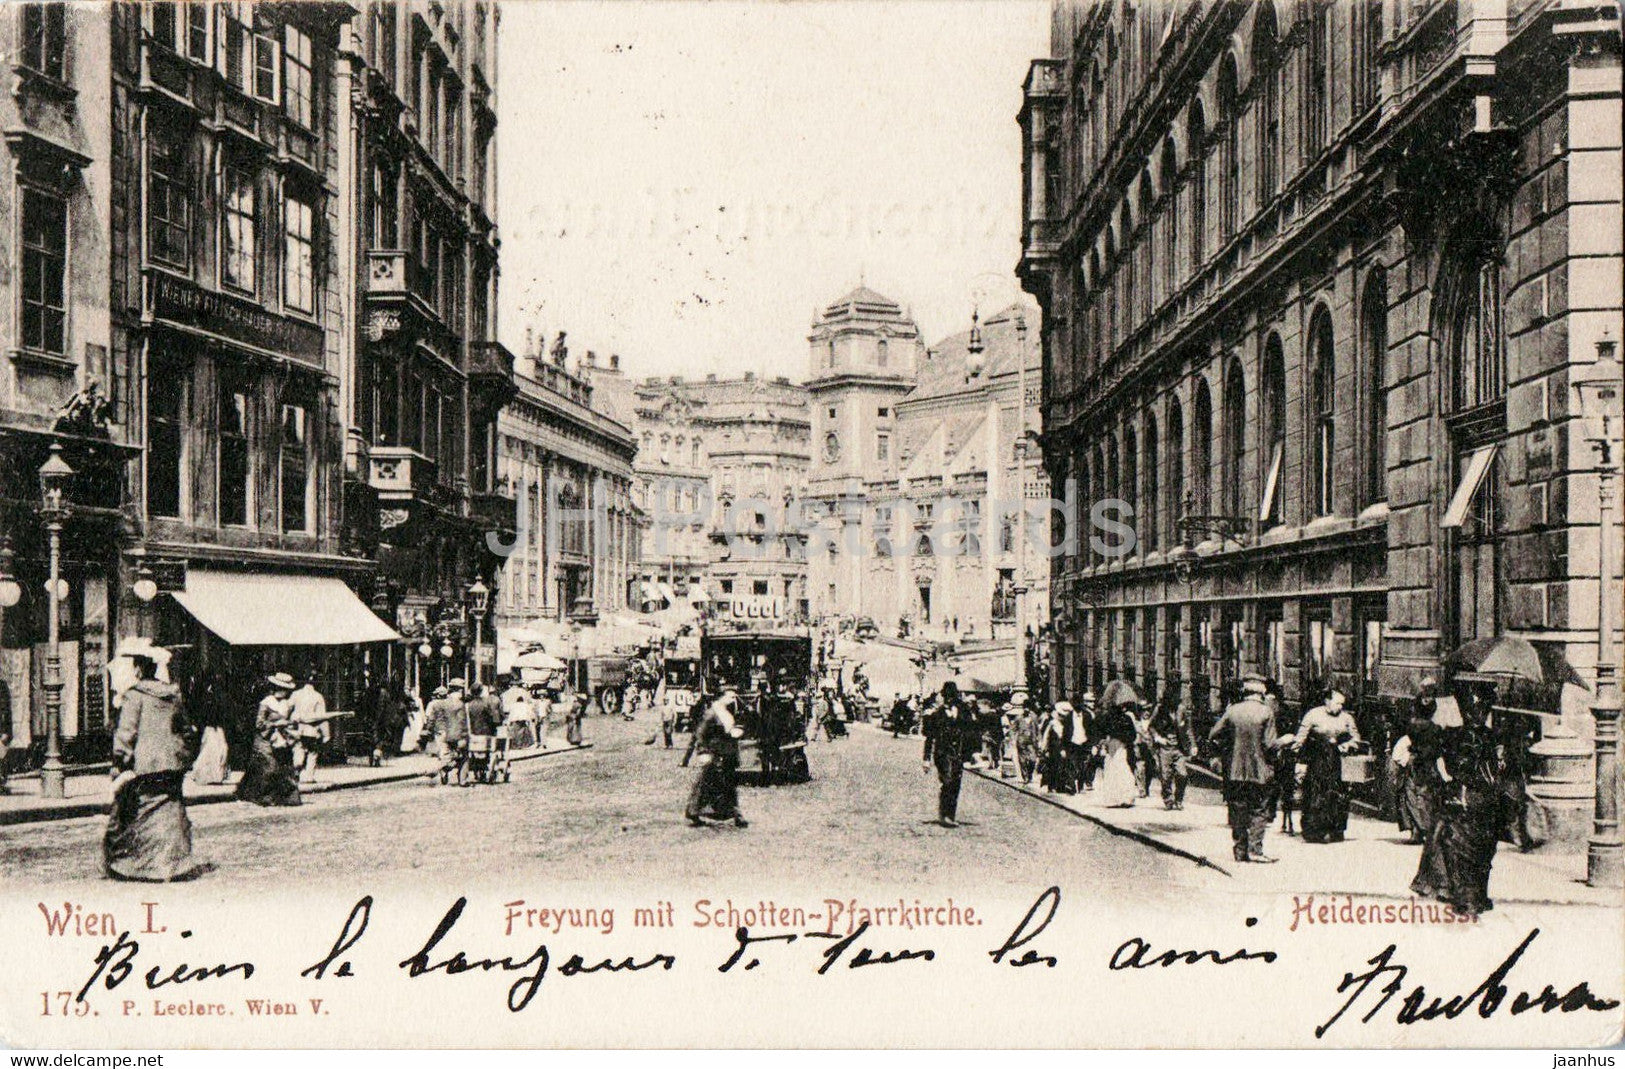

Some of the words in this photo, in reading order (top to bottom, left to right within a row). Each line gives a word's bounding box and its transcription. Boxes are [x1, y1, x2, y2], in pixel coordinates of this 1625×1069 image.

[38, 902, 117, 937] Wien
[140, 902, 168, 935] I.
[504, 901, 615, 936] Freyung
[634, 903, 675, 928] mit
[693, 899, 983, 937] Schotten-Pfarrkirche.
[1110, 917, 1278, 971] amis
[122, 1000, 142, 1017] P.
[246, 1000, 298, 1017] Wien
[308, 999, 330, 1016] V.
